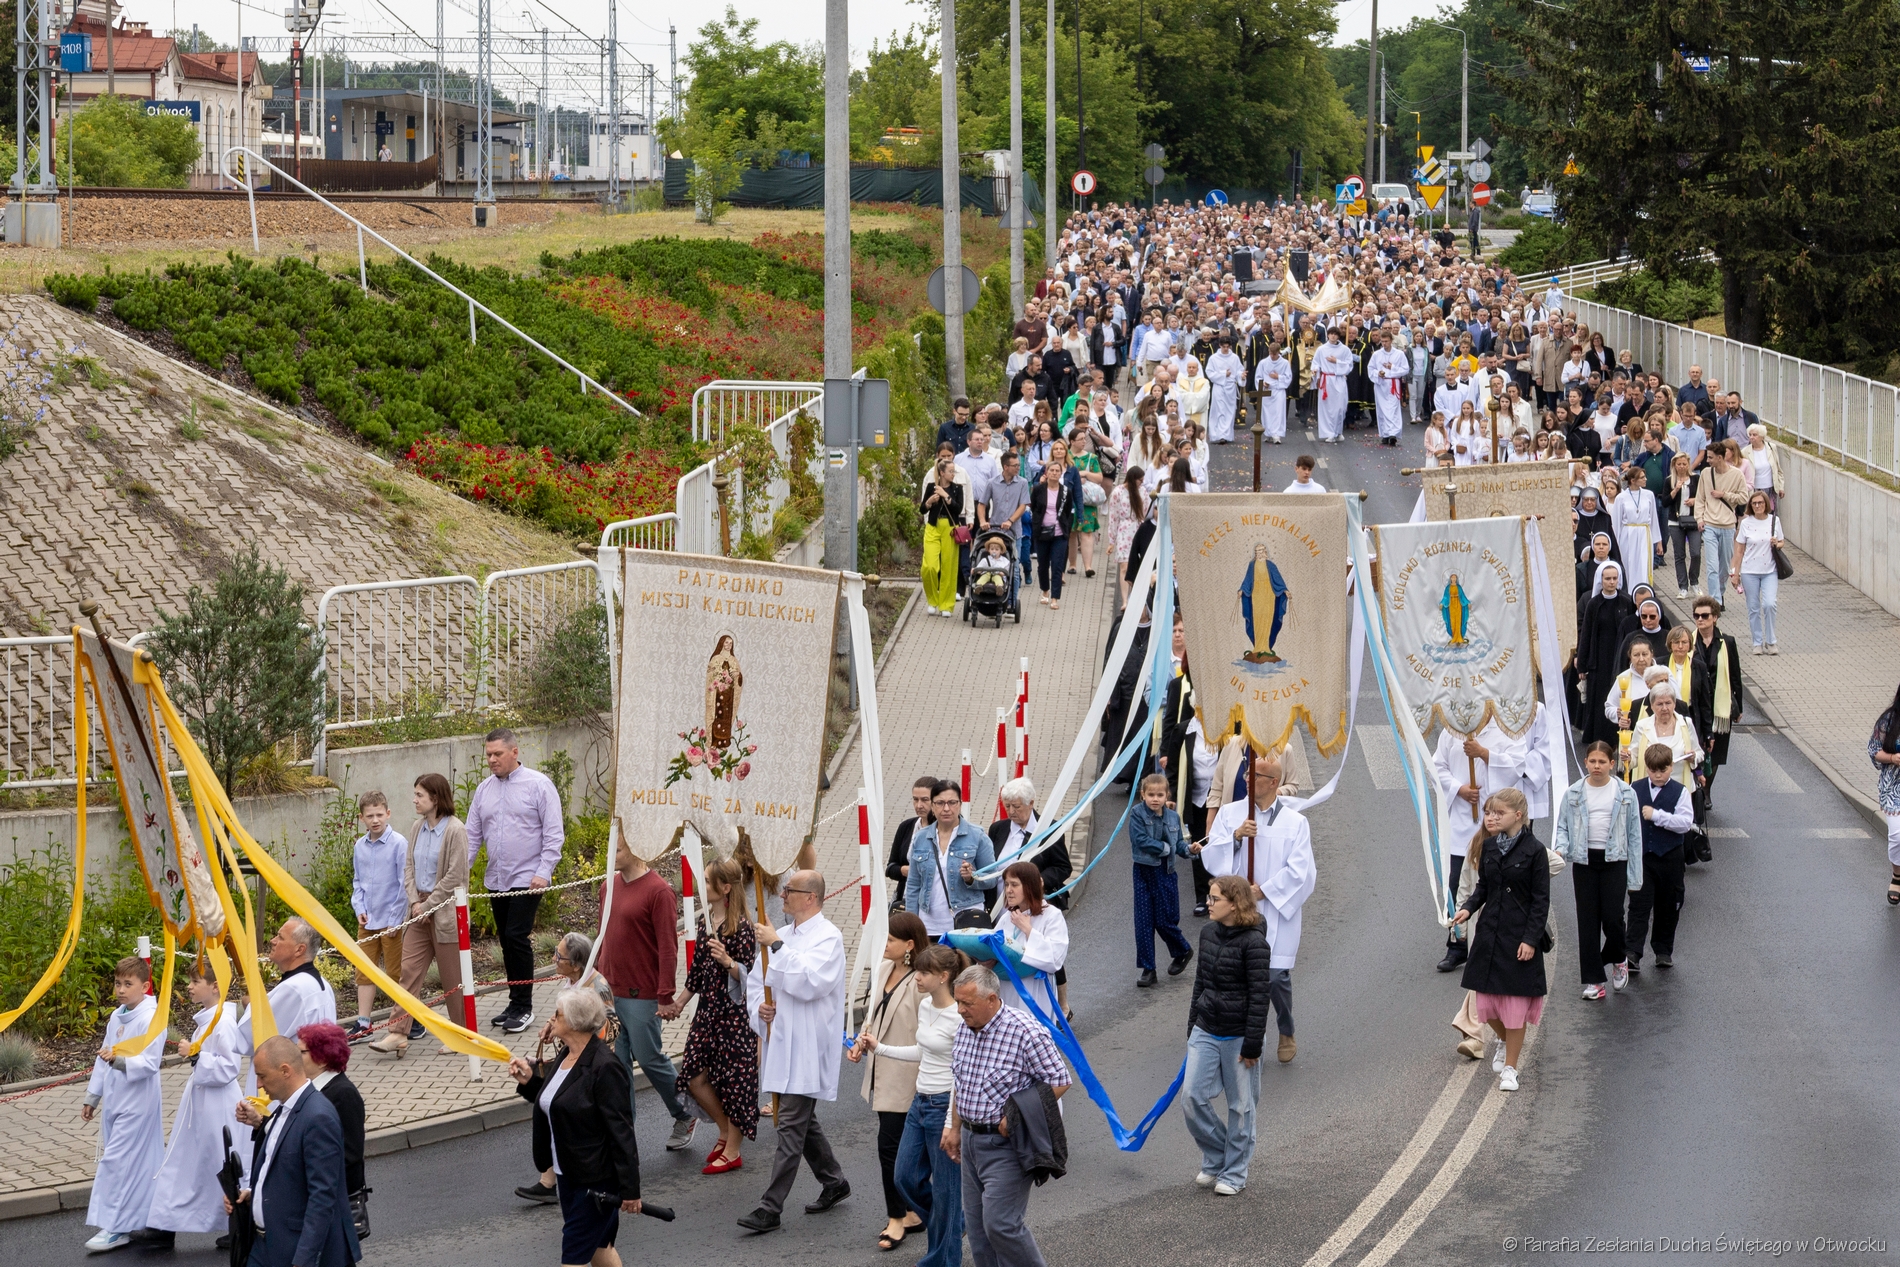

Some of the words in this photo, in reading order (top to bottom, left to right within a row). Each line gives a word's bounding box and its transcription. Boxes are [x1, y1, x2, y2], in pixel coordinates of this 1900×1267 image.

[61, 43, 82, 54] R108
[147, 105, 192, 116] Otwock
[1481, 481, 1505, 493] NAM
[1509, 477, 1562, 492] CHRYSTE
[1200, 521, 1233, 557] PRZEZ
[678, 569, 783, 597] PATRONKO
[641, 591, 690, 609] MISJI
[703, 596, 816, 623] KATOLICKICH
[1469, 673, 1485, 687] ZA
[1489, 647, 1515, 676] NAMI
[1230, 675, 1245, 693] DO
[1253, 677, 1310, 702] JEZUSA
[724, 798, 742, 814] ZA
[754, 801, 798, 821] NAMI
